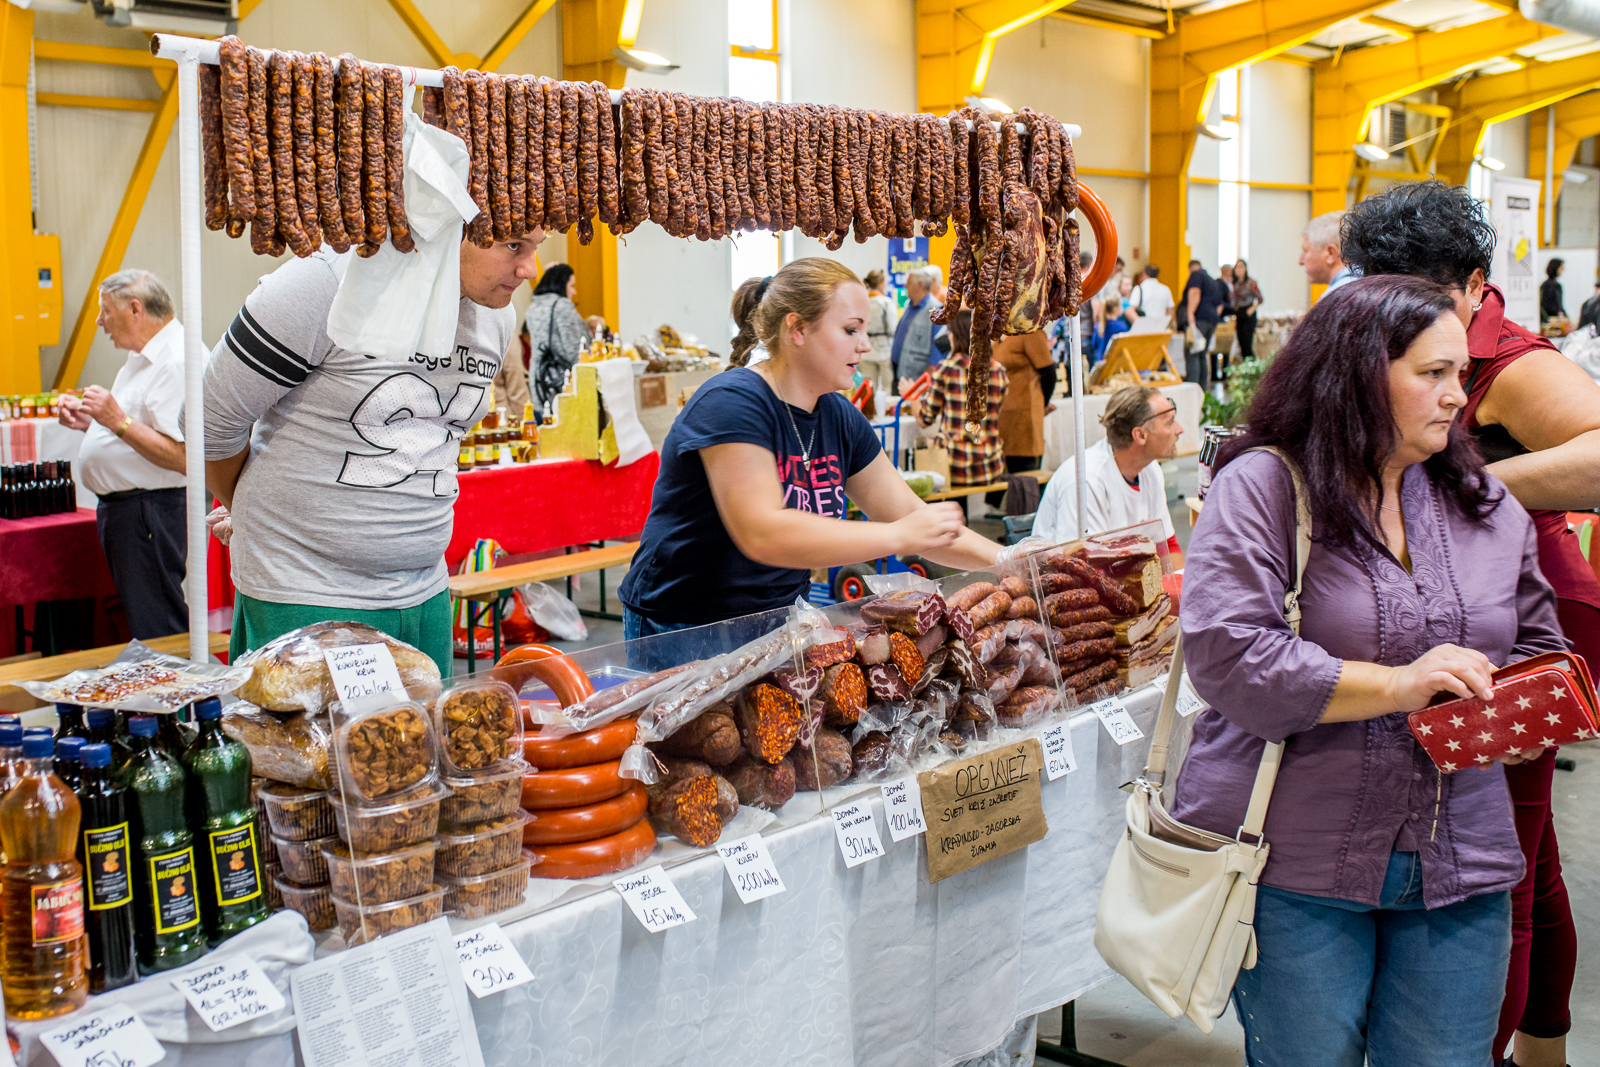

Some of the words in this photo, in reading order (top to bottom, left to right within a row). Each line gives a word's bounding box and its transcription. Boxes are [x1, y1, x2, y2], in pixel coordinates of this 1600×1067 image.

[456, 345, 497, 379] Team
[777, 450, 843, 489] VIES
[955, 764, 990, 797] OPG
[892, 794, 907, 806] KARE
[940, 805, 965, 822] SVETI
[968, 798, 986, 812] KRIŽ
[736, 851, 759, 865] KULEN
